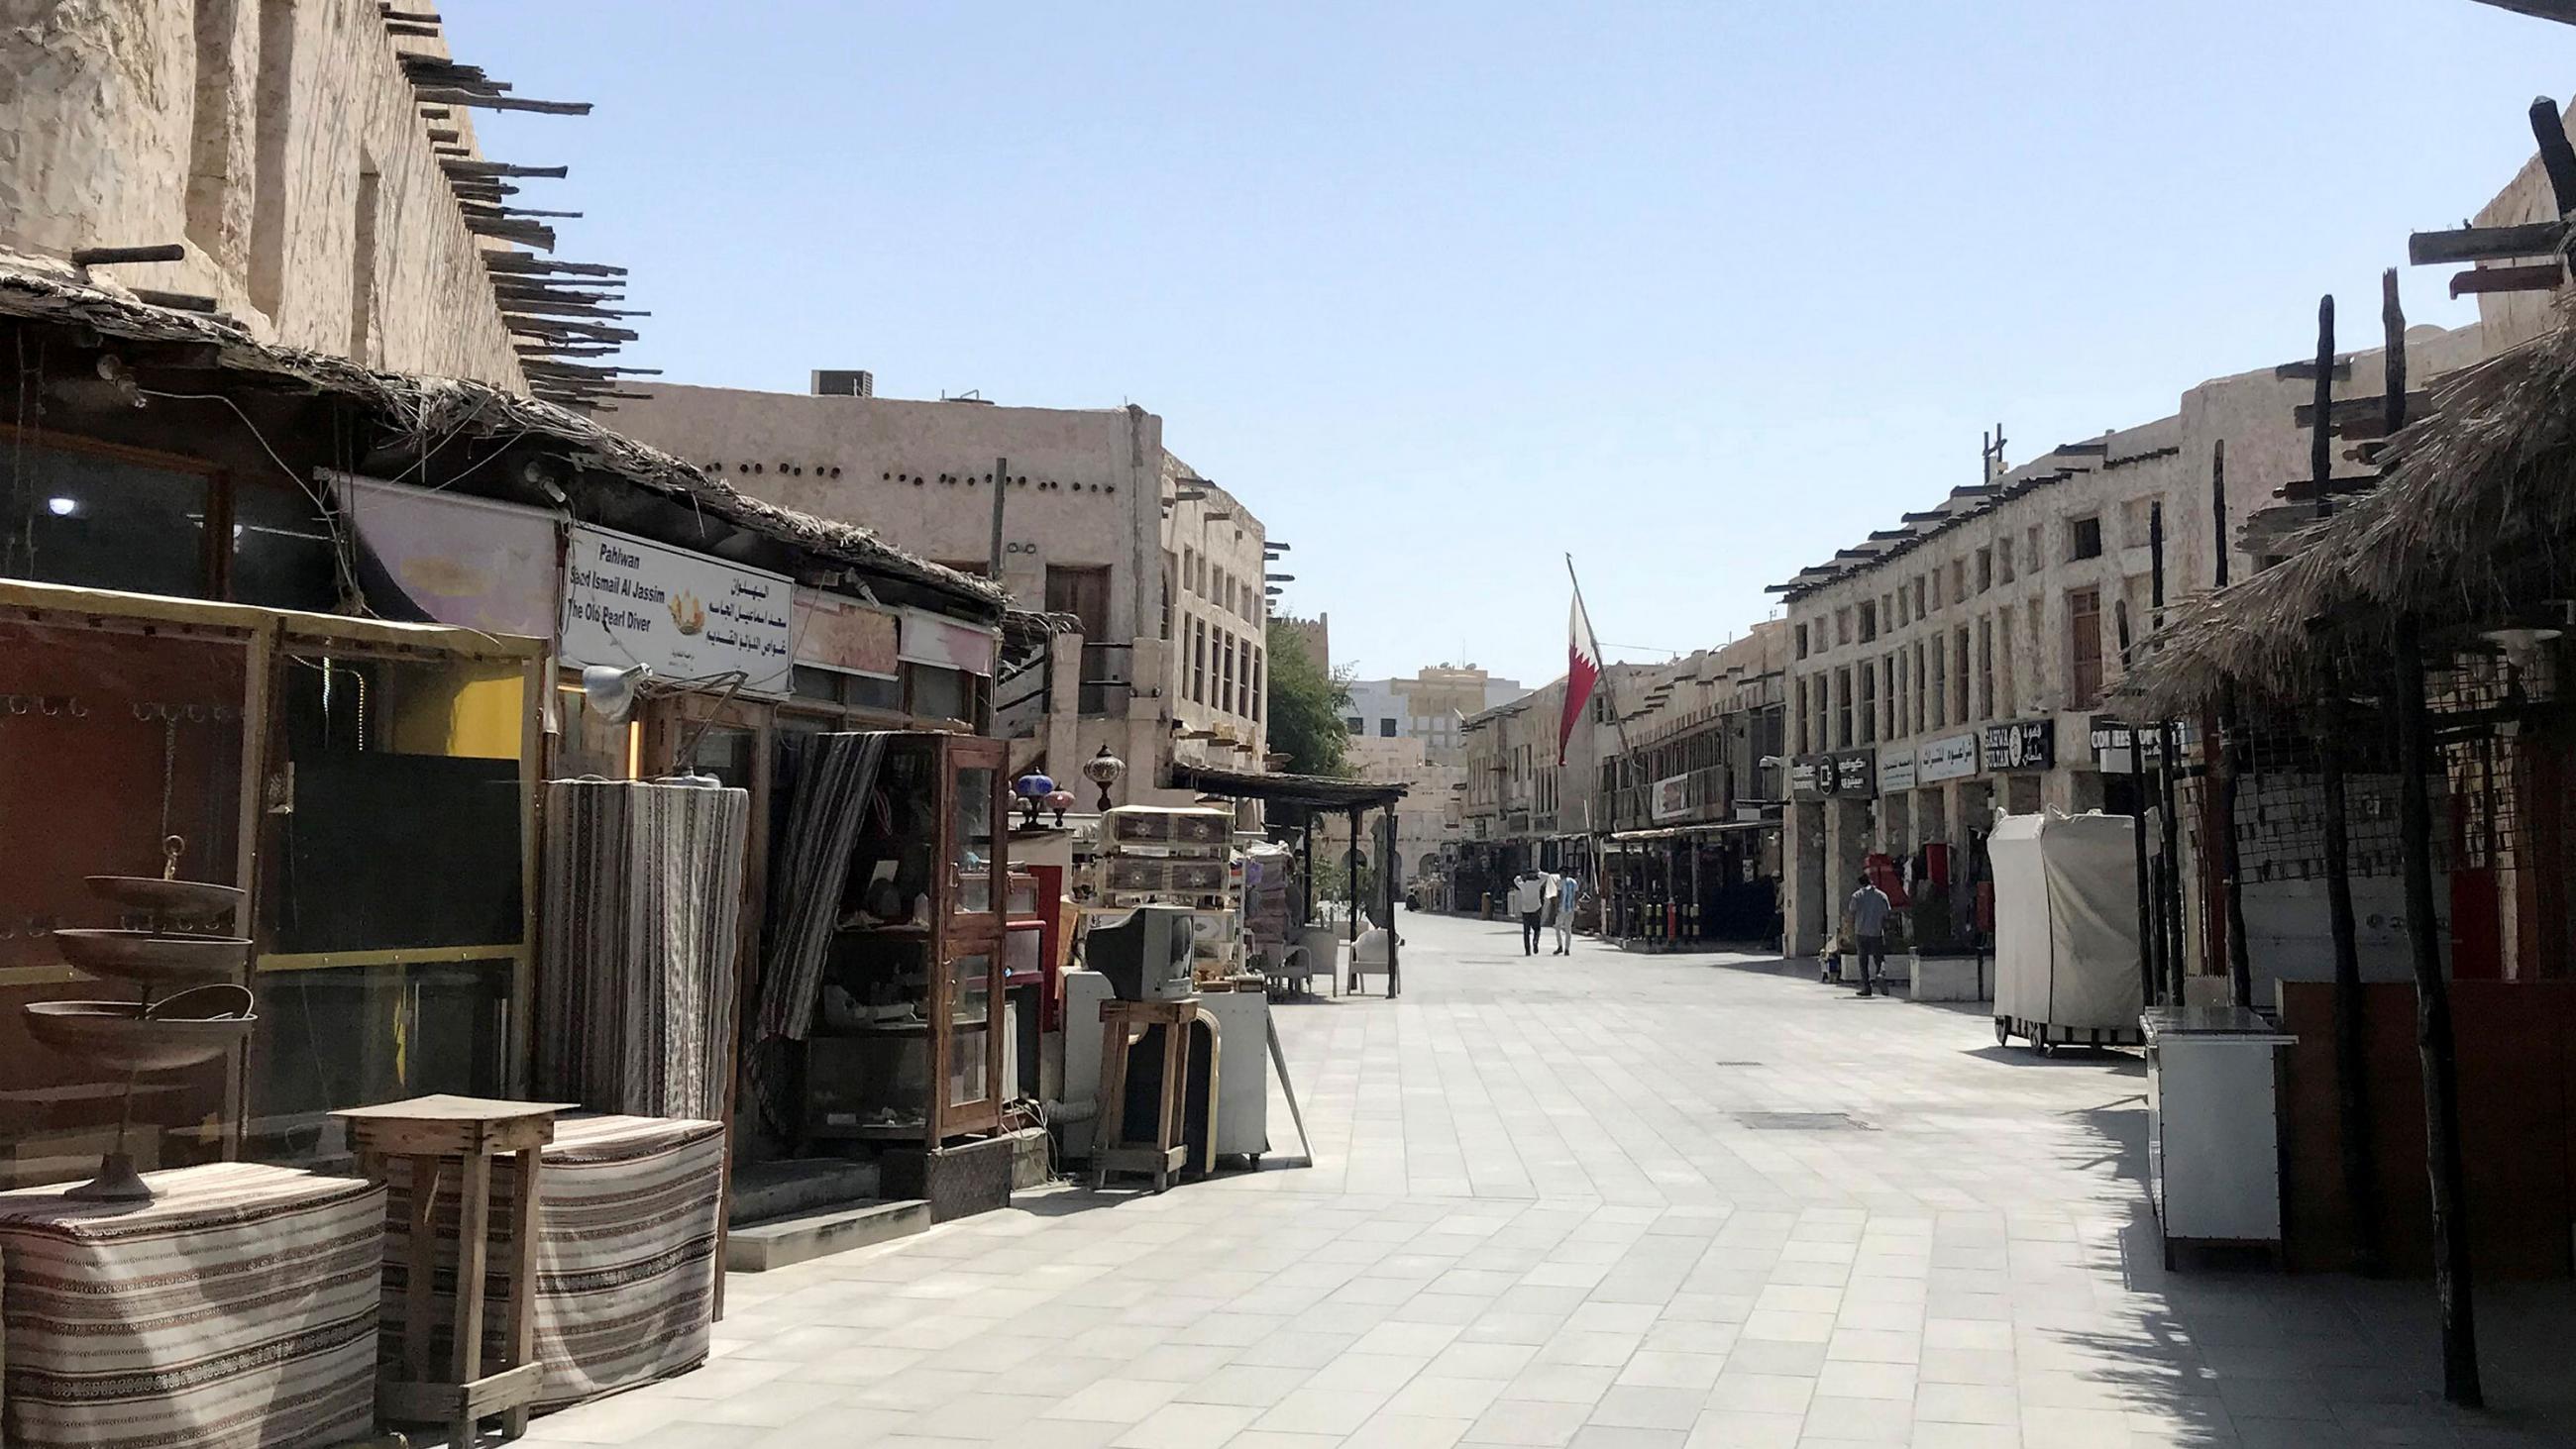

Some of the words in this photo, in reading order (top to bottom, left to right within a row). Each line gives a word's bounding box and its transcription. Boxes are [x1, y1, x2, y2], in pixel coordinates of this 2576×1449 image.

[598, 543, 640, 569] Pahlwan
[592, 571, 619, 594] Ismail
[621, 578, 631, 597] Al
[632, 581, 665, 603] Jassim
[568, 598, 583, 619] The
[585, 602, 600, 623] Old
[601, 606, 625, 628] Pearl
[626, 611, 651, 633] Diver
